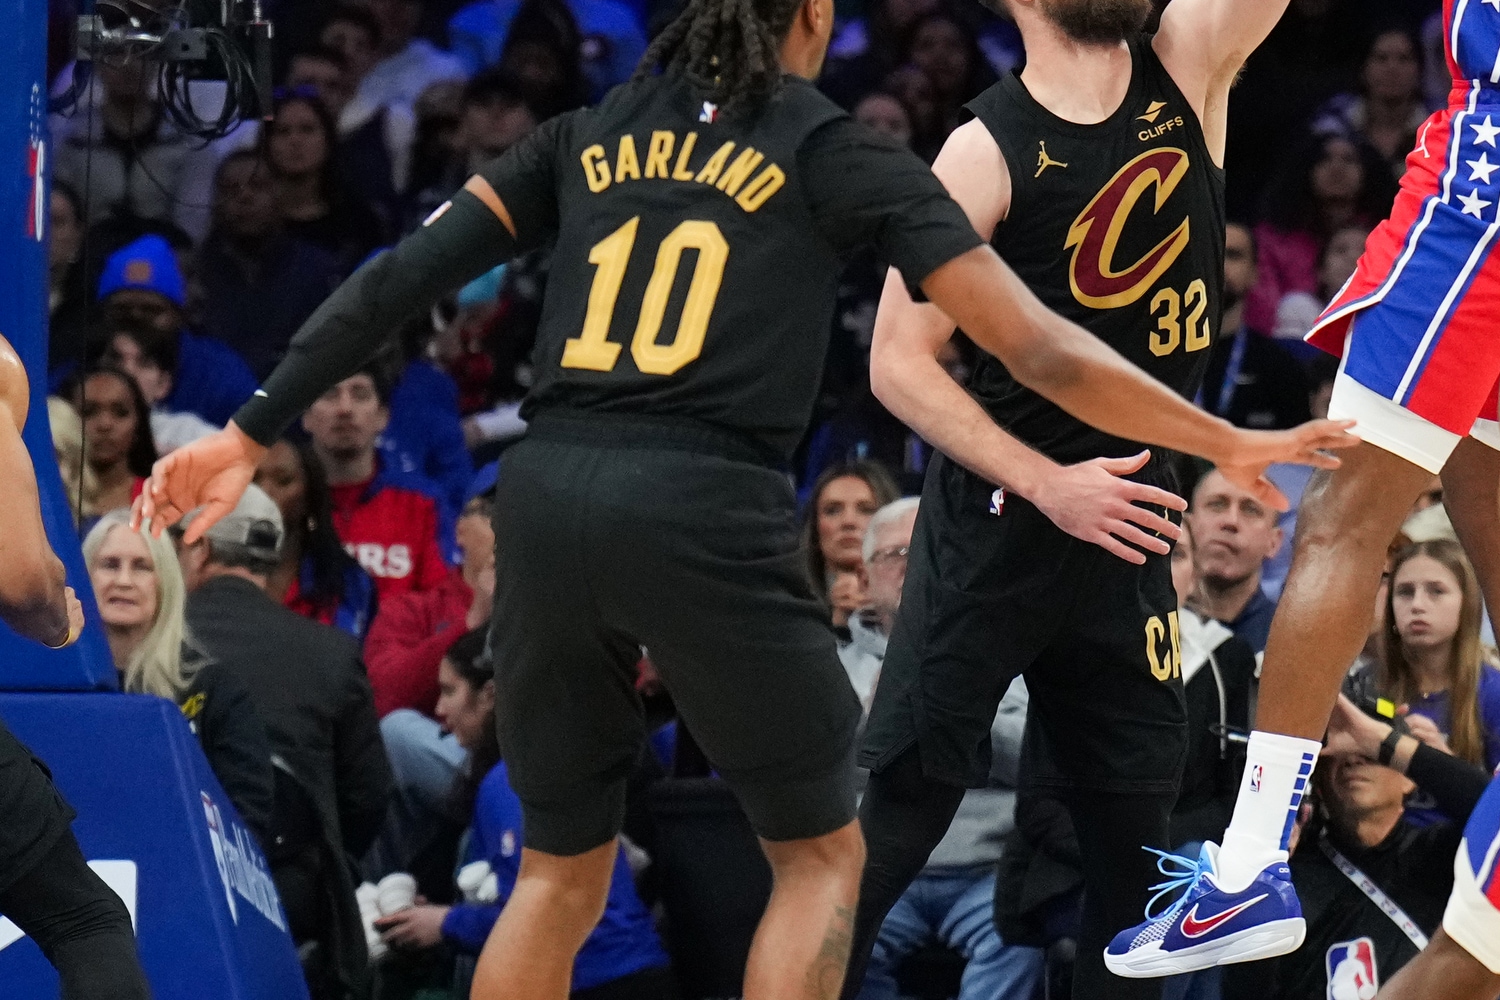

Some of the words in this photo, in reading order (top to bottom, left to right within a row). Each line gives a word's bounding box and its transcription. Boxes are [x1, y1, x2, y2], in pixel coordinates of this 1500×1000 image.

[1138, 116, 1184, 141] CLIFFS
[580, 130, 786, 212] GARLAND
[561, 215, 730, 375] 10
[1149, 278, 1210, 357] 32
